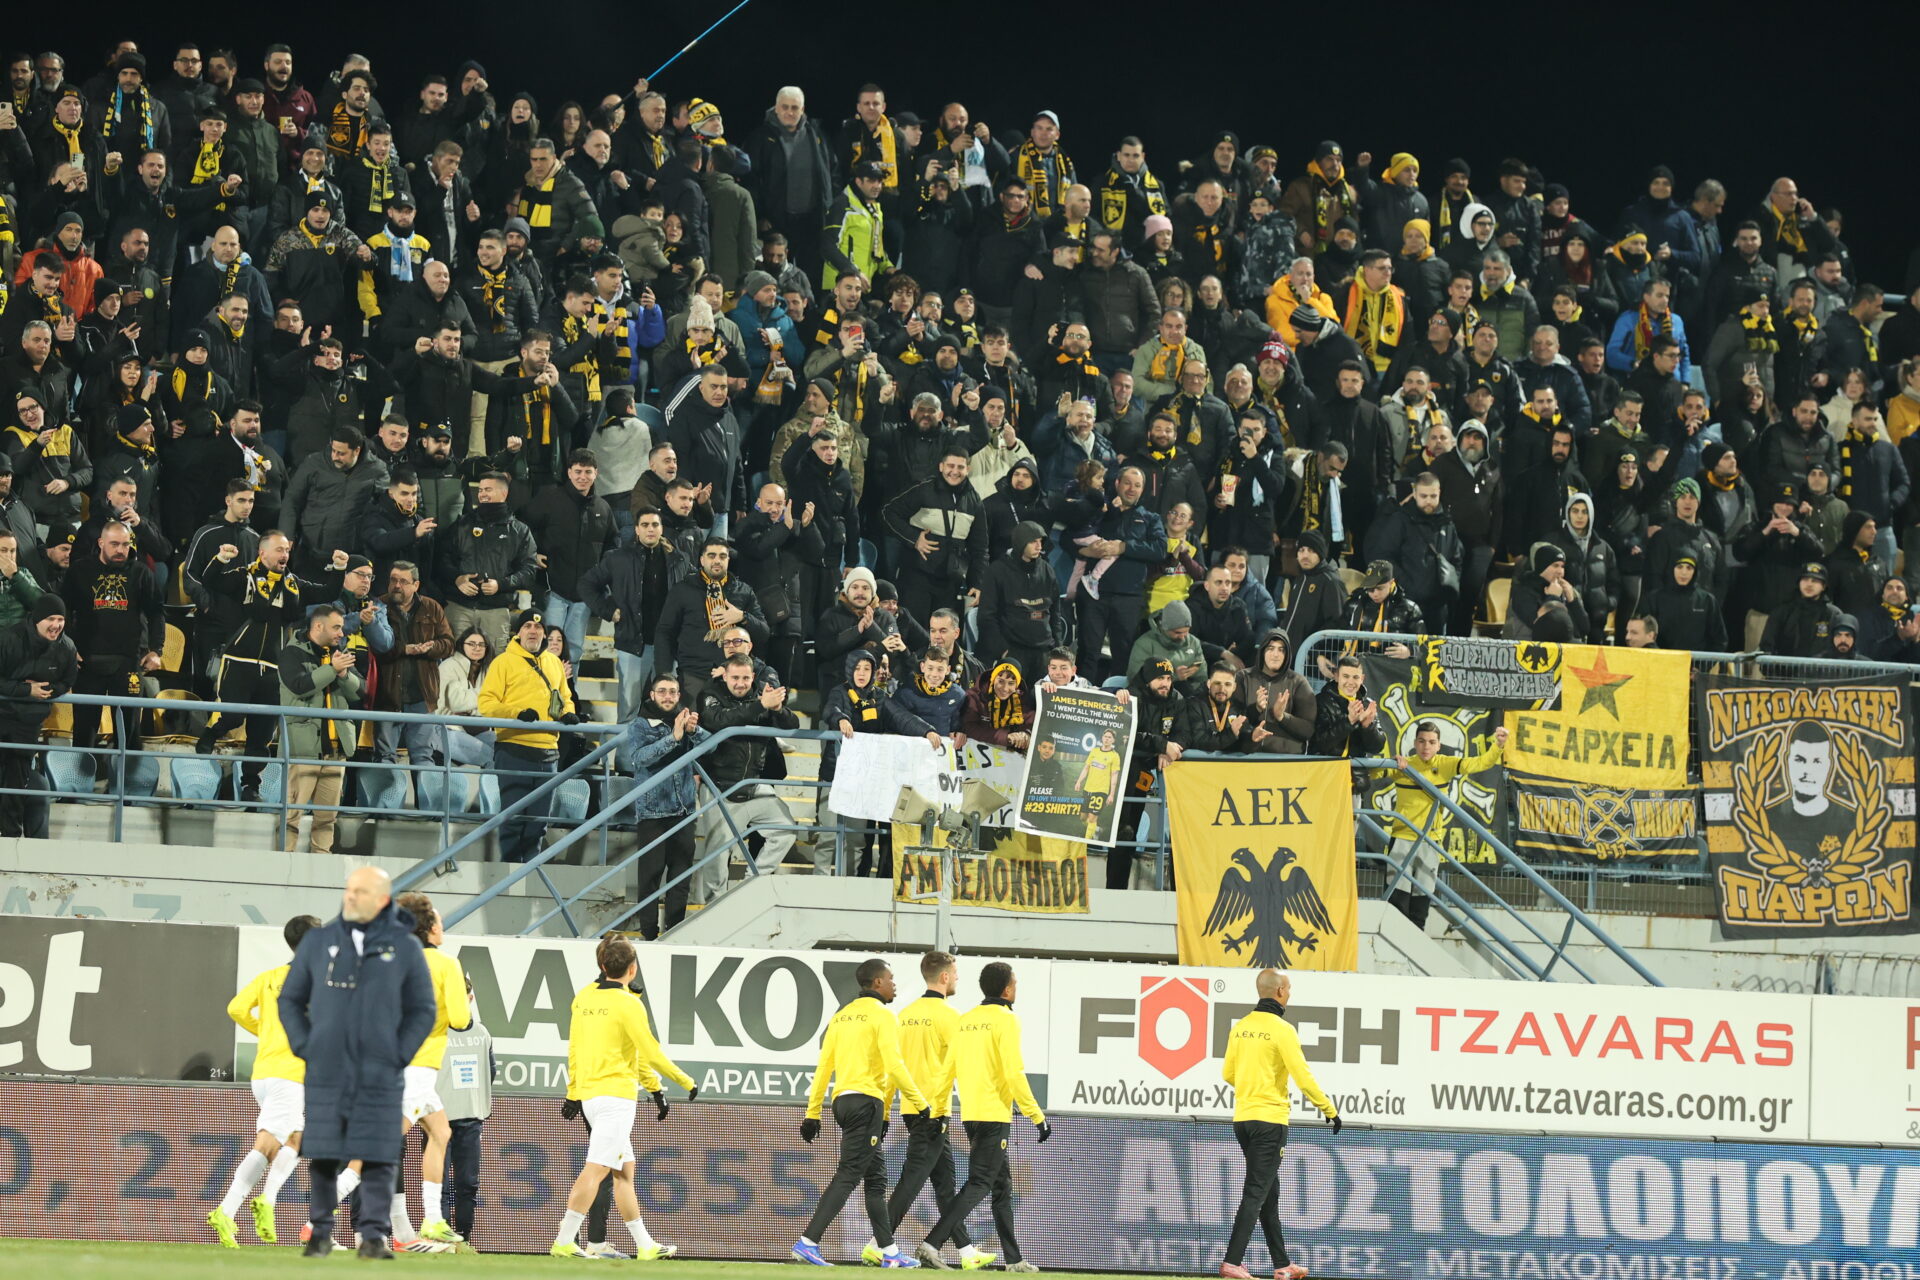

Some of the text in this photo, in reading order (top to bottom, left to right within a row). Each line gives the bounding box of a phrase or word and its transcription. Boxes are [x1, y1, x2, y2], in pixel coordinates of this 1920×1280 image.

[1051, 695, 1077, 705] JAMES
[1113, 705, 1124, 713] 29
[1056, 712, 1094, 724] LIVINGSTON
[1057, 704, 1076, 713] WENT
[1076, 708, 1088, 716] ALL
[1103, 712, 1118, 720] WAY
[1709, 689, 1903, 747] ΝΙΚΟΛΑΚΗΣ
[1052, 732, 1075, 742] Welcome
[1516, 716, 1676, 770] ΕΞΑΡΧΕΙΑ
[1029, 787, 1053, 795] PLEASE
[1024, 802, 1081, 815] #29 SHIRT?!
[1088, 796, 1104, 810] 29
[1211, 786, 1313, 826] ΑΕΚ
[1720, 863, 1910, 924] ΠΑΡΩΝ
[855, 1014, 868, 1022] FC
[921, 1018, 932, 1027] FC
[980, 1023, 992, 1031] FC
[448, 1038, 464, 1048] ALL
[1258, 1032, 1271, 1041] FC
[1415, 1006, 1794, 1067] TZAVARAS
[210, 1067, 228, 1078] 21+
[1431, 1081, 1793, 1132] www.tzavaras.com.gr
